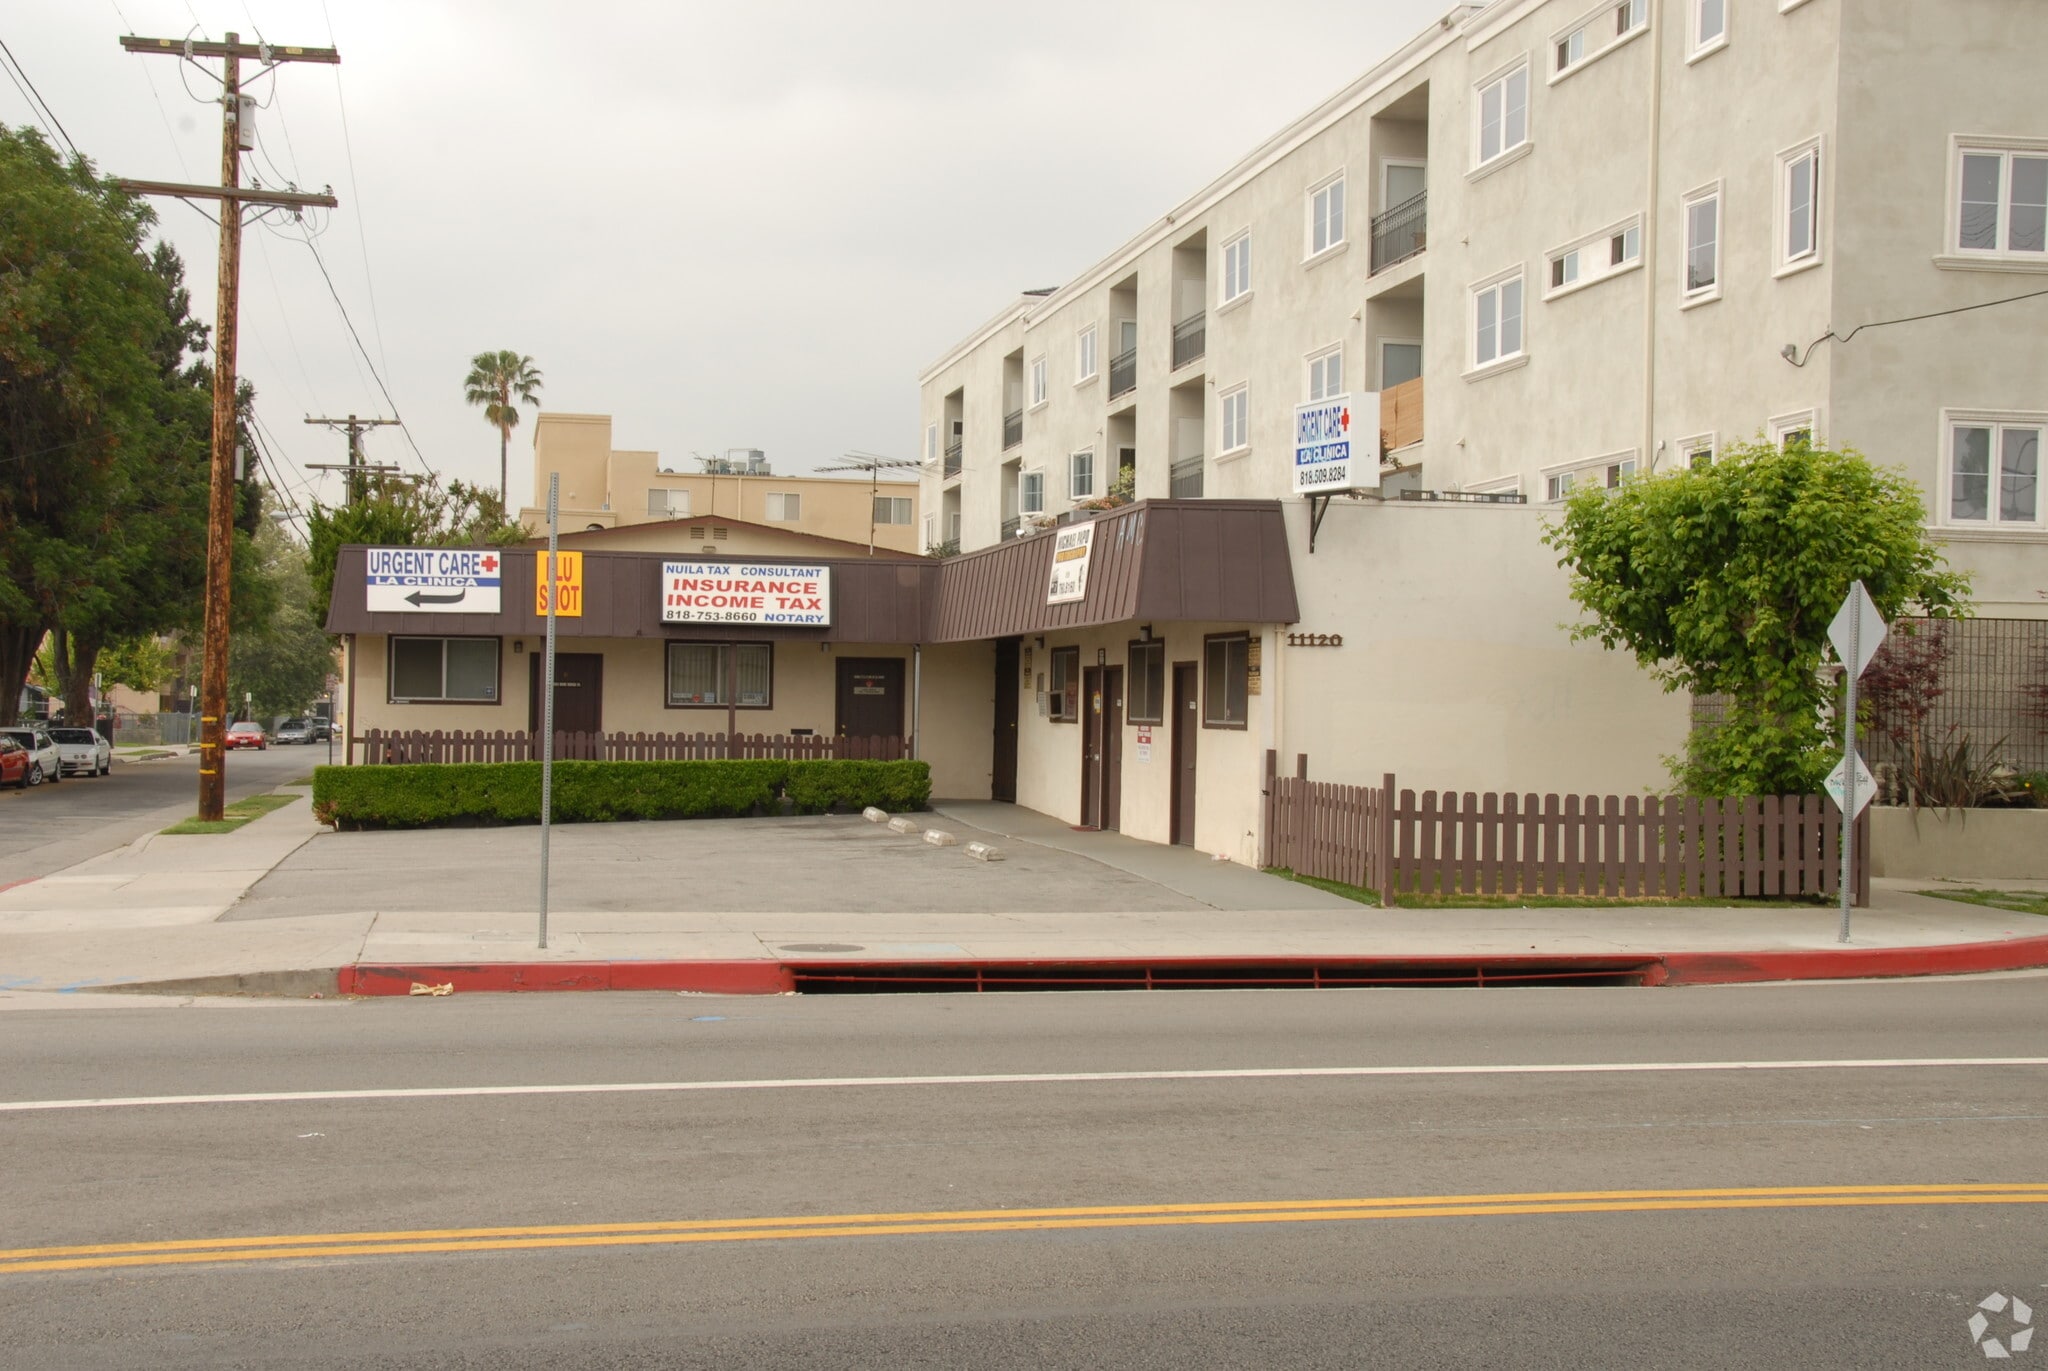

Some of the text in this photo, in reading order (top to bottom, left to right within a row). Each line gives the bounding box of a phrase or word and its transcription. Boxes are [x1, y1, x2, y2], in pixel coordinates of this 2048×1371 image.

[1297, 406, 1341, 444] URGENT CARE
[1300, 443, 1347, 464] LA CLINICA
[370, 551, 481, 576] URGENT CARE
[666, 564, 822, 577] NUILA TAX CONSULTANT
[375, 576, 478, 587] LA CLINICA
[673, 578, 818, 595] INSURANCE
[667, 594, 822, 610] INCOME TAX
[666, 610, 824, 623] 818-753-8660 NOTARY
[1287, 633, 1343, 647] 11120
